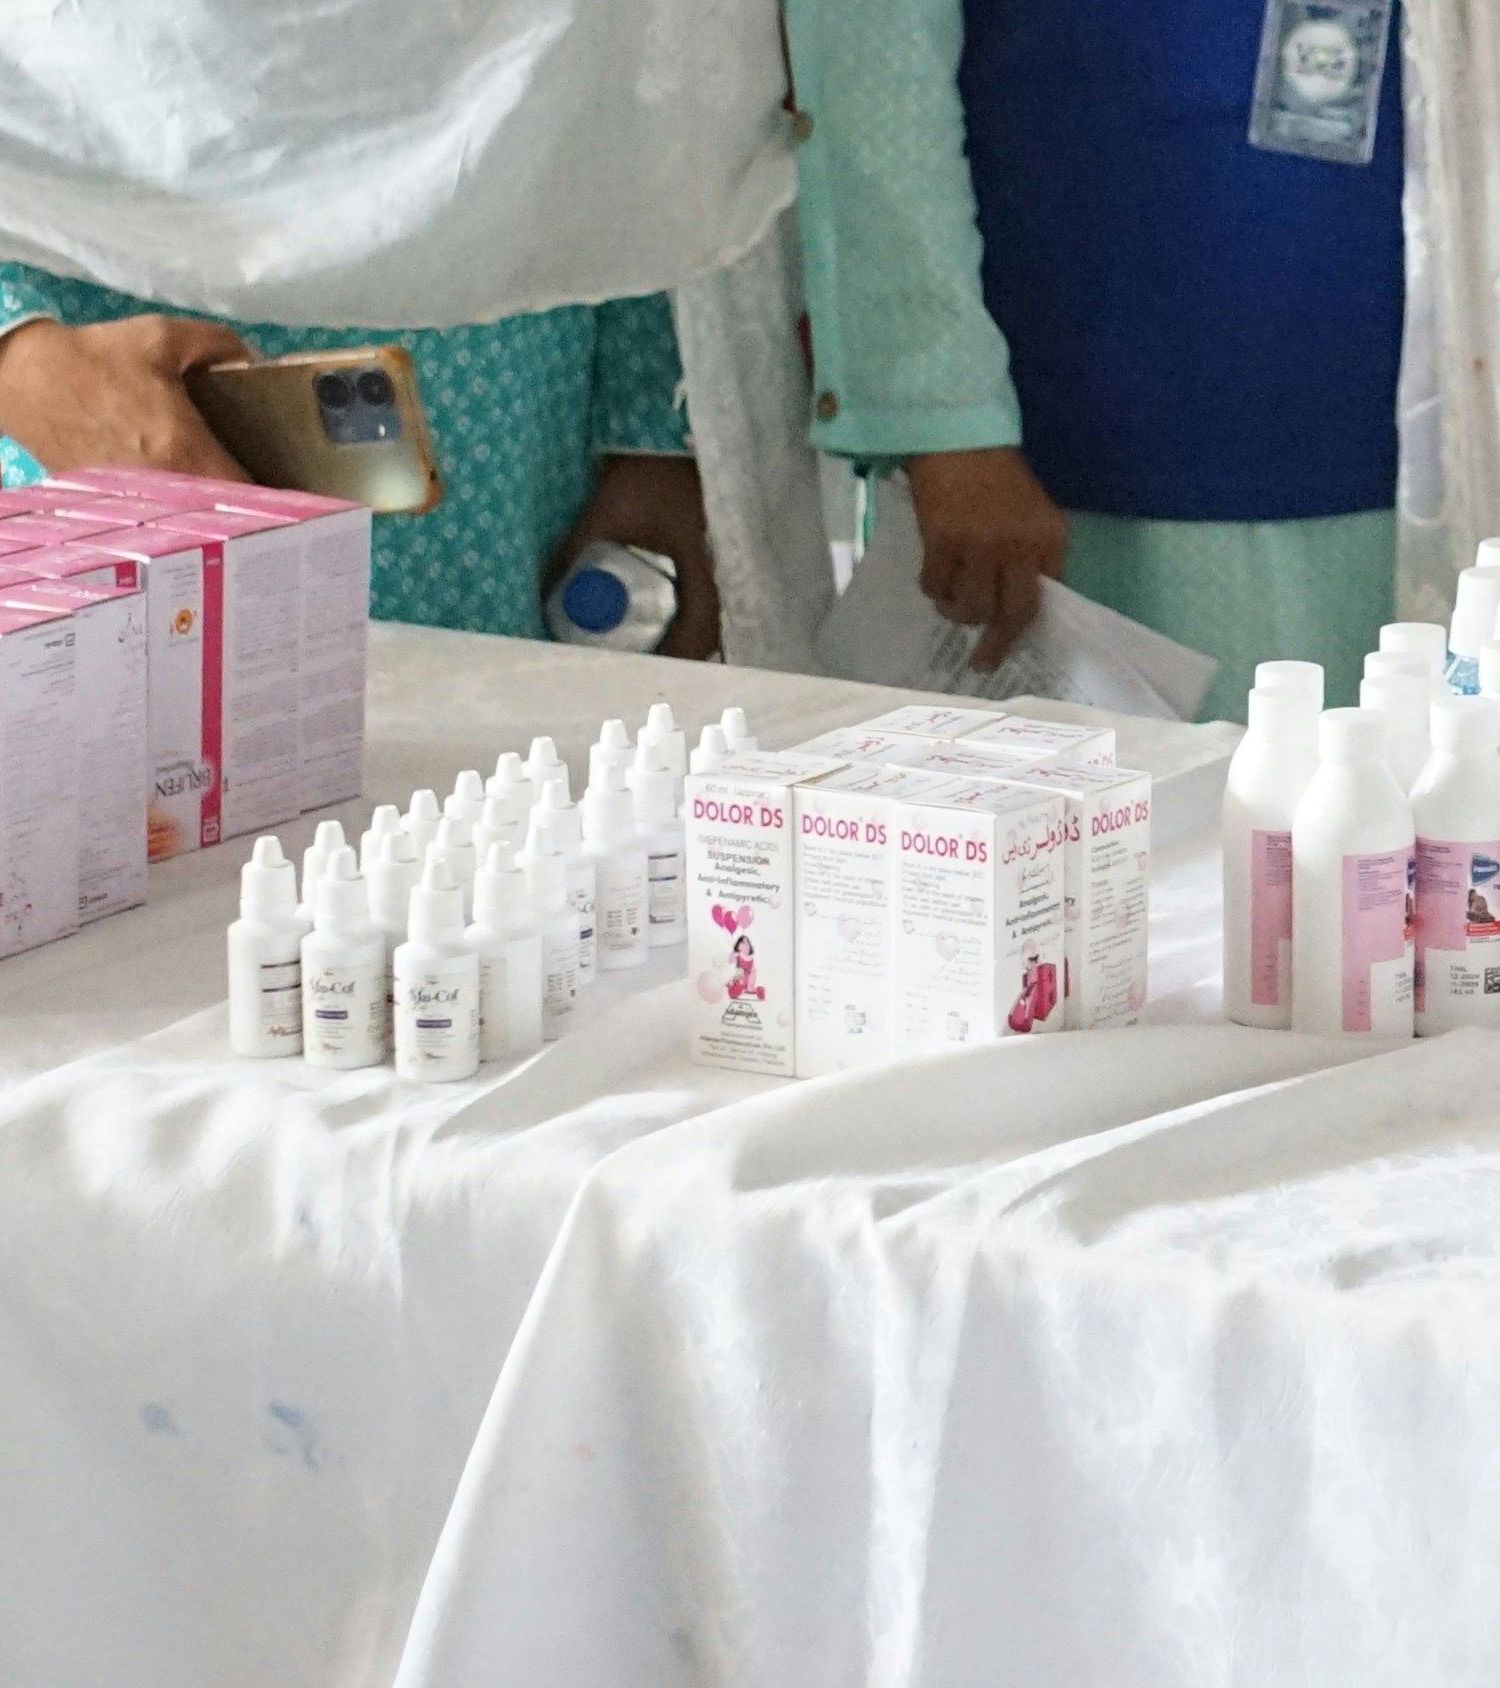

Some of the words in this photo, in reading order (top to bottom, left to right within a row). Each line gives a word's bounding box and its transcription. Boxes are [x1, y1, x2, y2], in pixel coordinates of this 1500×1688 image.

[152, 767, 212, 799] BRUFEN
[693, 799, 753, 826] DOLOR
[760, 806, 784, 829] DS
[802, 814, 860, 842] DOLOR
[865, 823, 888, 845] DS
[1092, 806, 1131, 837] DOLOR
[1134, 800, 1149, 823] DS
[707, 849, 771, 866] SUSPENSION
[901, 830, 960, 860] DOLOR
[965, 840, 988, 863] DS
